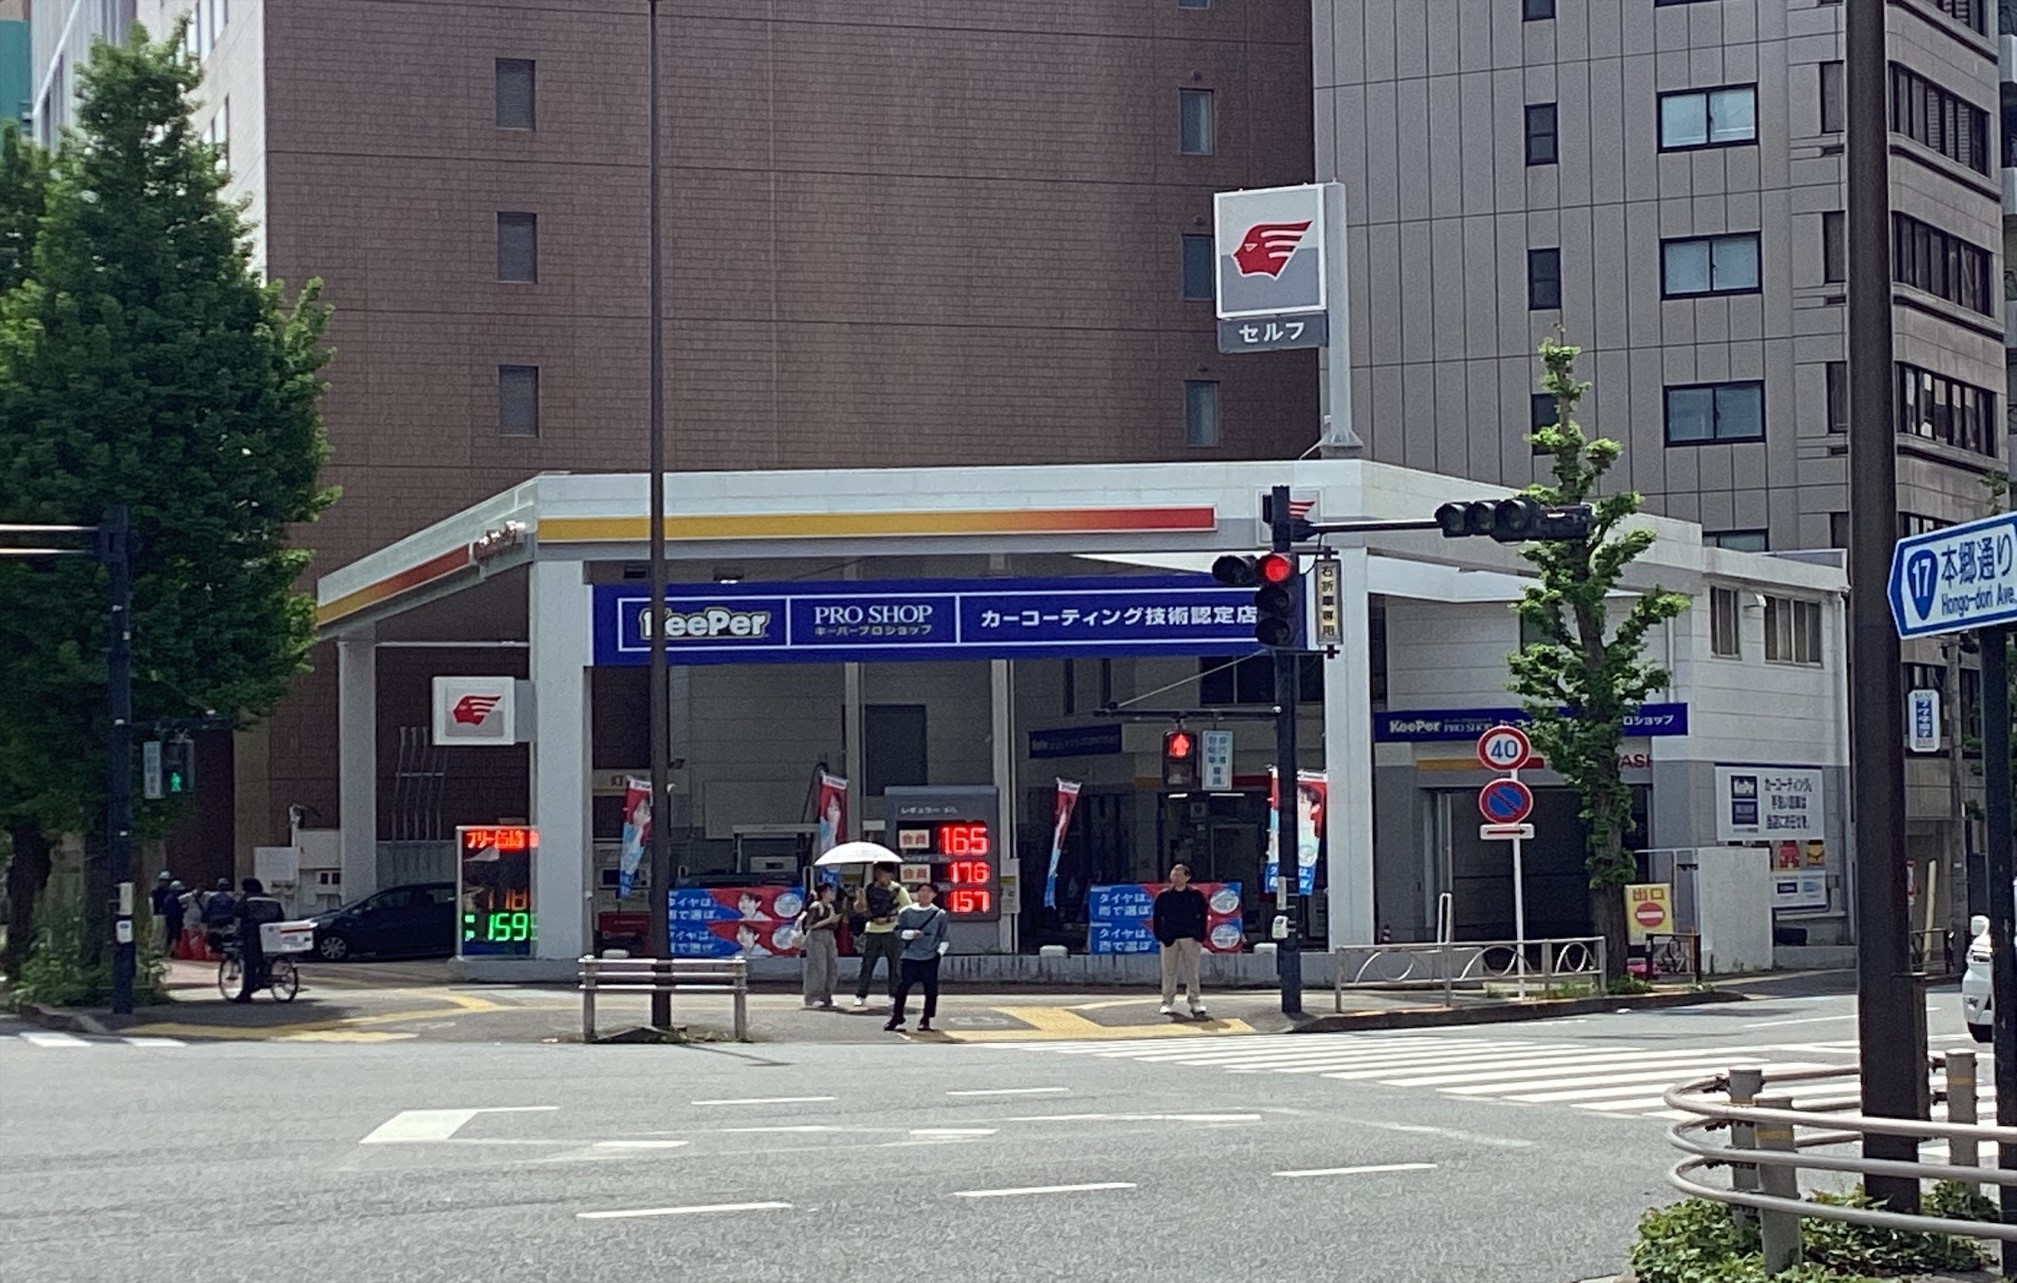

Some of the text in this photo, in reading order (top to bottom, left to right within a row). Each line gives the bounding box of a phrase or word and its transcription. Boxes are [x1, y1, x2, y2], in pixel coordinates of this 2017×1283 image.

[1239, 321, 1304, 343] セルフ
[1941, 534, 2013, 590] 本郷通り
[1912, 558, 1931, 598] 17
[1941, 585, 1993, 617] Hongo-dori
[814, 604, 933, 624] PRO SHOP
[980, 604, 1257, 628] カーコーティング技術認定店
[815, 624, 932, 637] キーパープロショップ
[1389, 719, 1441, 733] KeePer
[1491, 739, 1518, 759] 40
[939, 826, 989, 856] 165
[949, 860, 991, 884] 176
[949, 889, 991, 914] 157
[1632, 887, 1665, 902] 出口
[487, 912, 529, 941] 159
